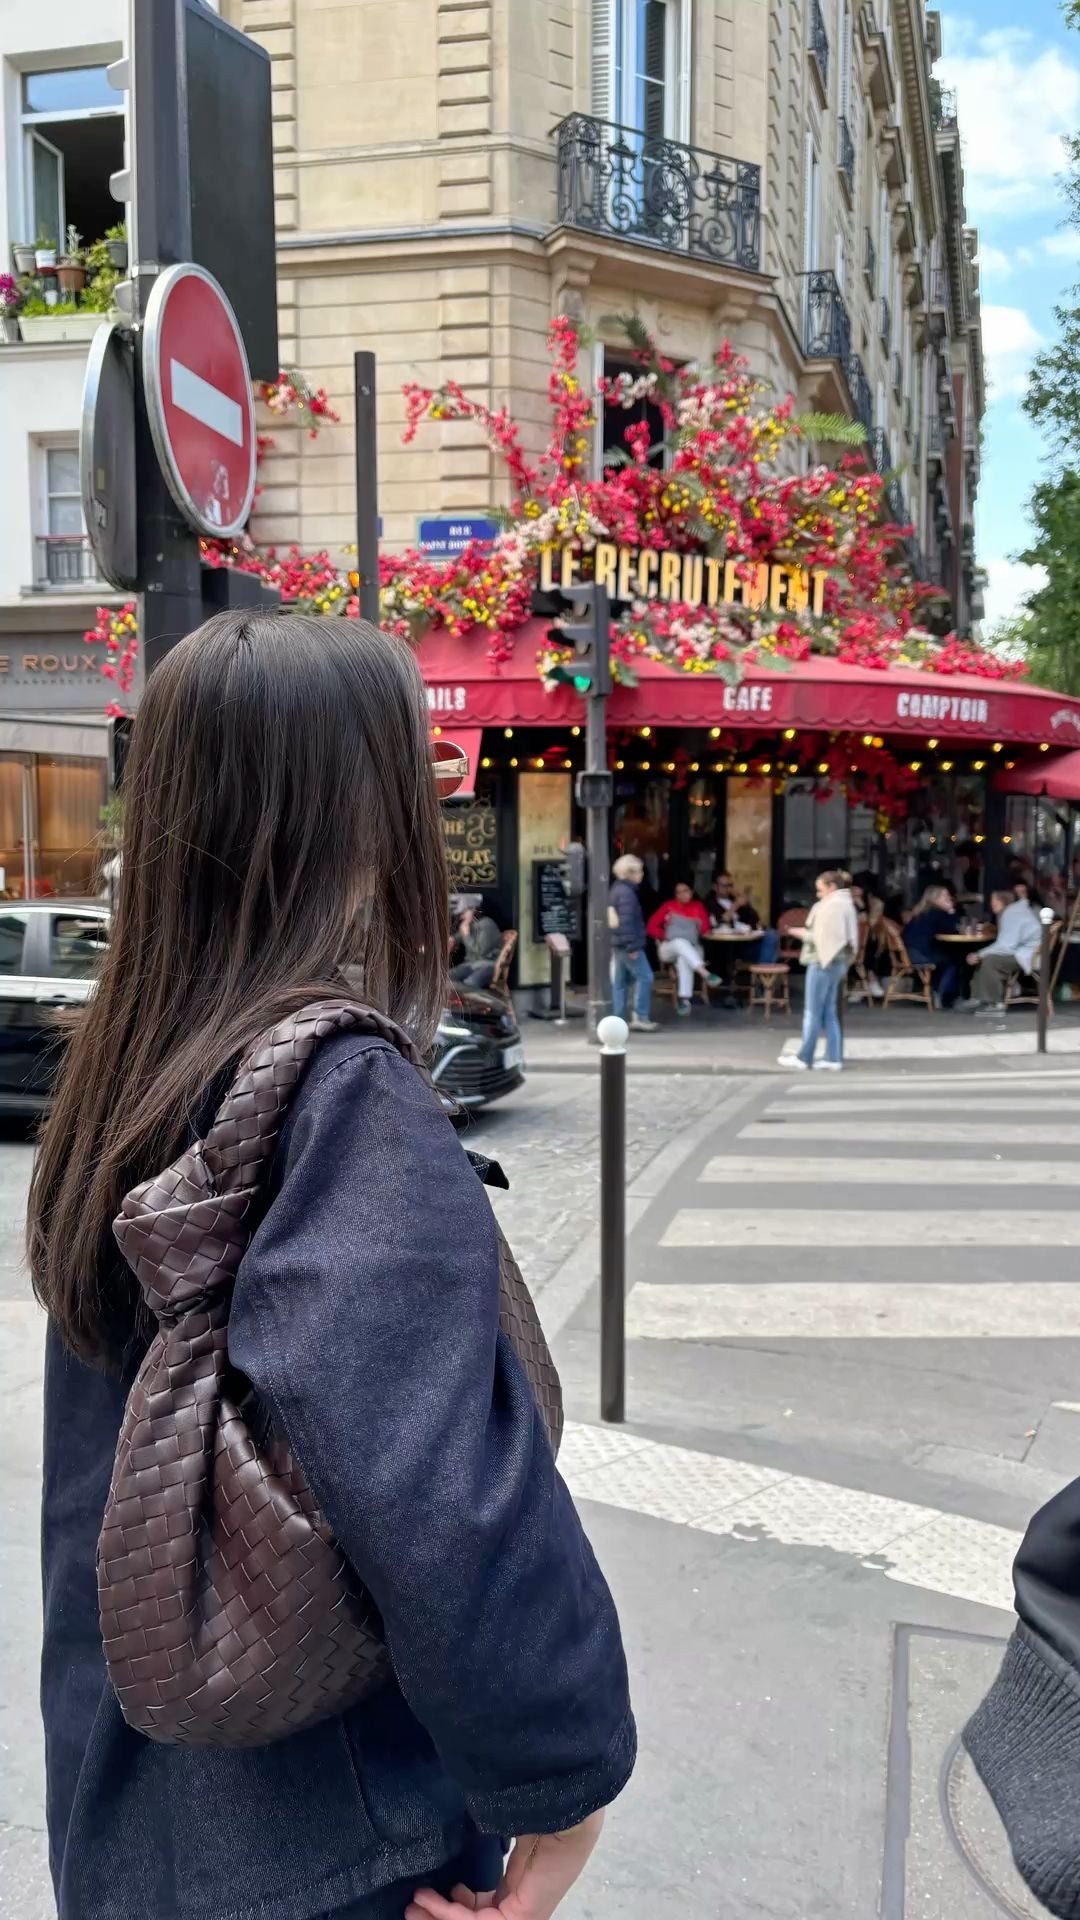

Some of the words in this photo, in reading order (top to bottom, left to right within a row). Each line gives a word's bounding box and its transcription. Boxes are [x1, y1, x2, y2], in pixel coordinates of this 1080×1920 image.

[539, 546, 582, 590] LE
[594, 543, 829, 617] RECRUTEMENT
[21, 654, 97, 672] ROUX
[723, 686, 773, 711] CAFE
[896, 692, 988, 723] COMPTOIR
